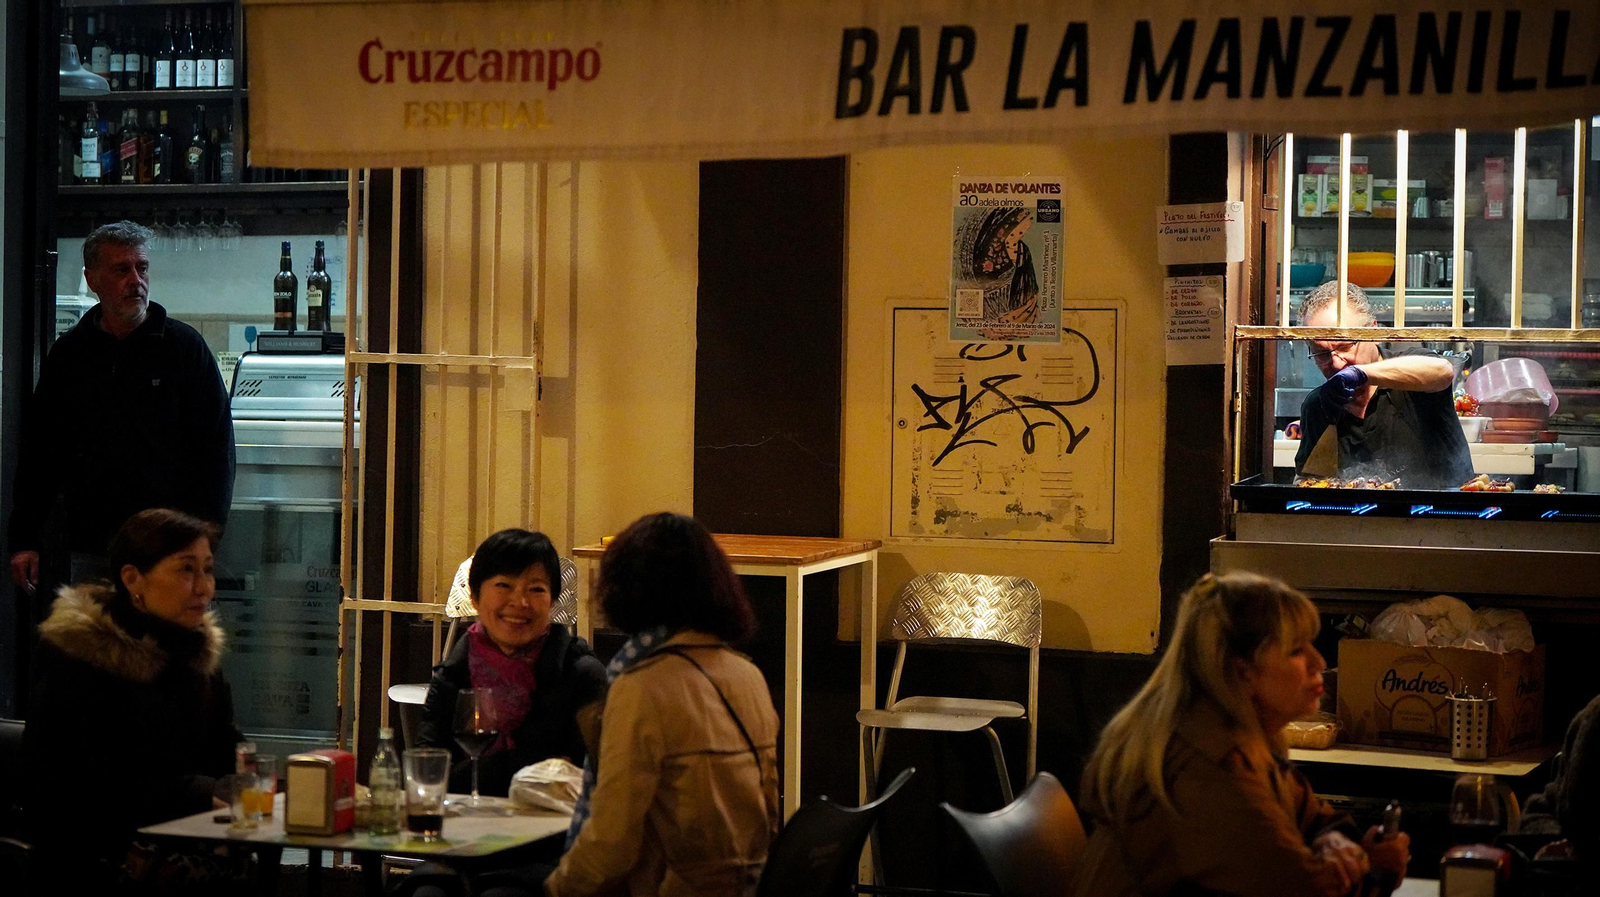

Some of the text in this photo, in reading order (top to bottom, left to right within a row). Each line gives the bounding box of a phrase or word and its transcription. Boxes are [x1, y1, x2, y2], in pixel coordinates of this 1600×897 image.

[357, 38, 601, 91] Cruzcampo
[835, 9, 1600, 119] BAR LA MANZANILL
[404, 98, 555, 131] ESPECIAL
[960, 183, 1061, 194] DANZA DE VOLANTES
[979, 198, 1000, 206] adela
[1000, 198, 1024, 206] olmos
[1382, 668, 1449, 695] Andrés
